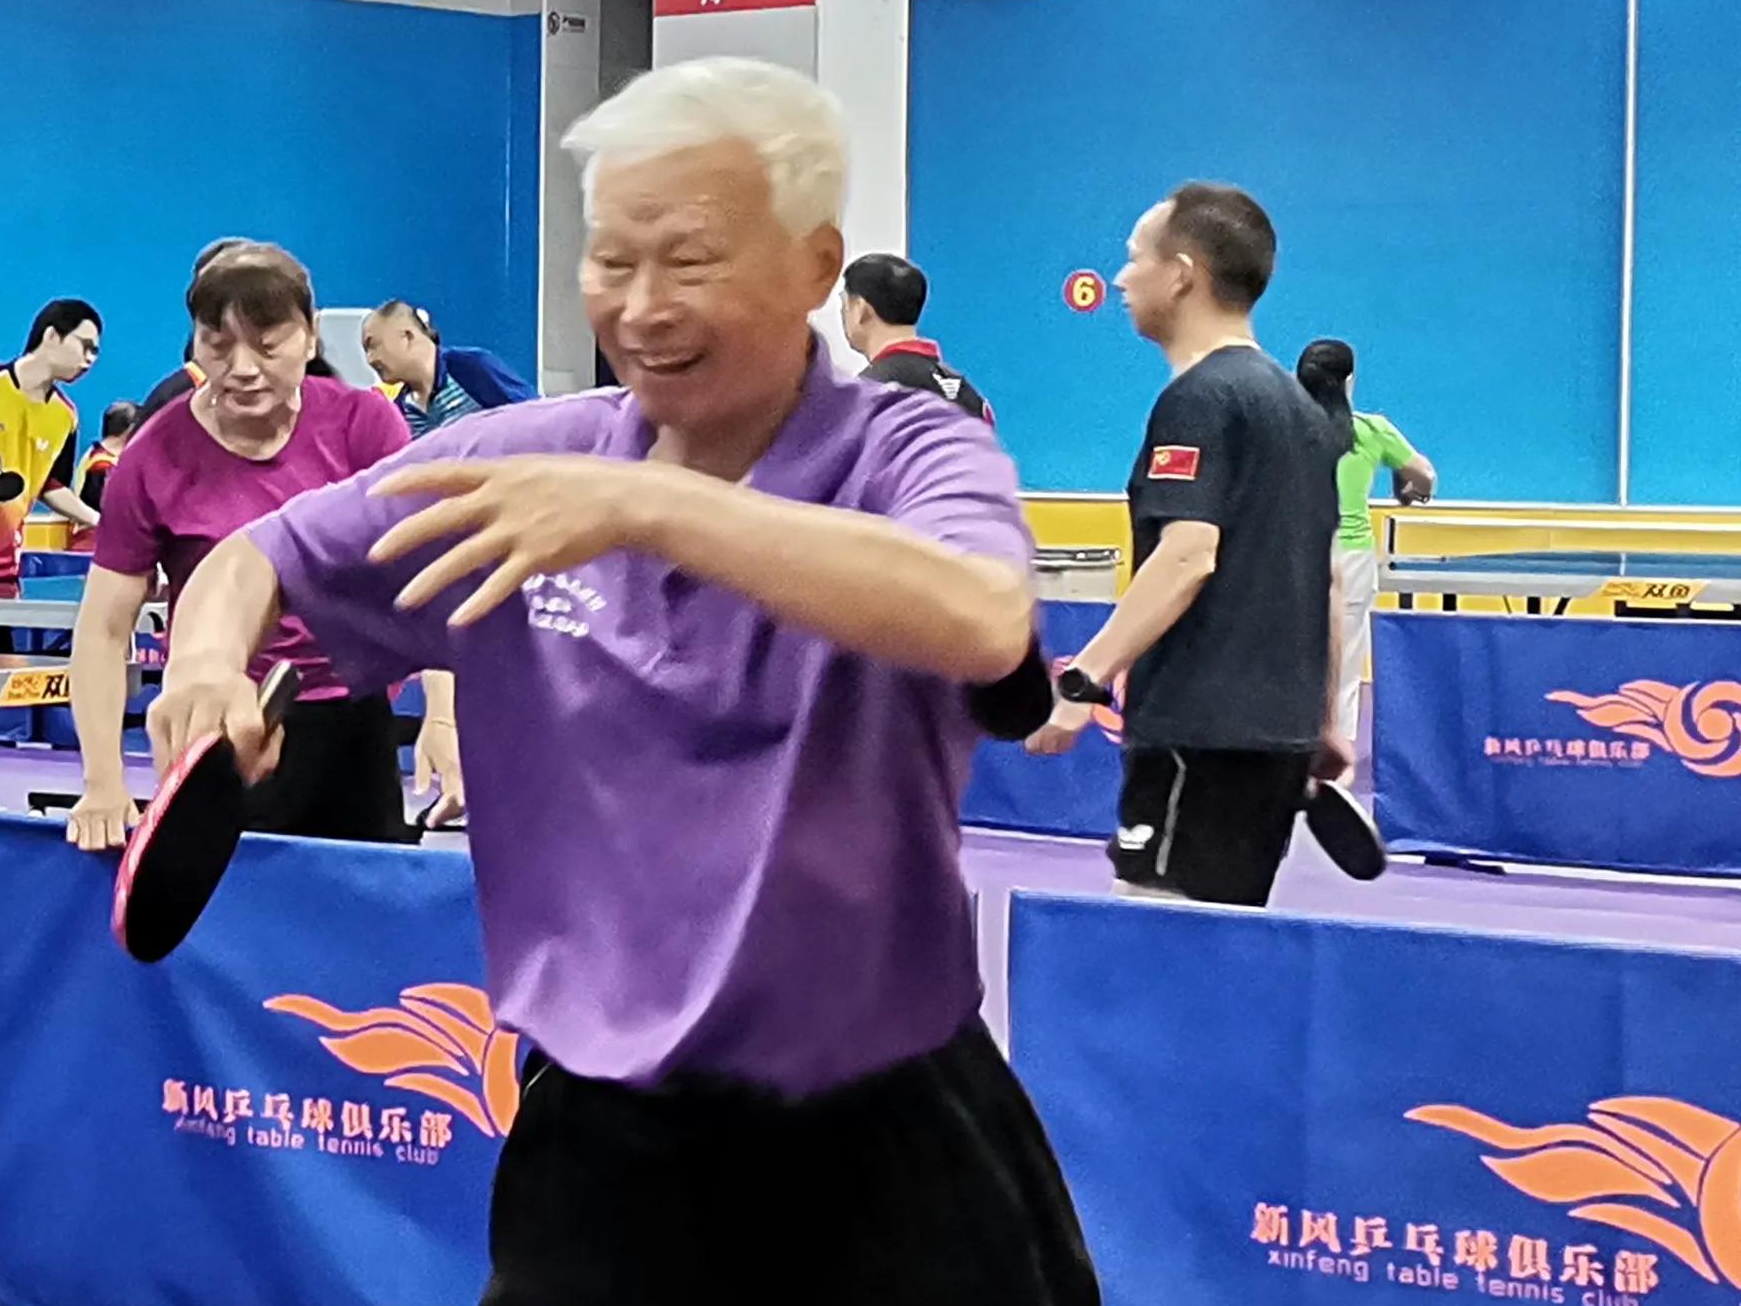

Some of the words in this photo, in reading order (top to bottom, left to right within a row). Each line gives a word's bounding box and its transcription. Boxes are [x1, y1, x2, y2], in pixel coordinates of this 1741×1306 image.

[1072, 276, 1097, 307] 6
[42, 673, 70, 700] 双
[161, 1077, 453, 1149] 新风乒乓球俱乐部
[247, 1125, 305, 1150] table
[318, 1132, 385, 1158] tennis
[395, 1144, 440, 1166] club
[1249, 1201, 1660, 1295] 新风乒乓球俱乐部
[1268, 1248, 1370, 1283] xinfeng
[1386, 1261, 1459, 1291] table
[1476, 1271, 1566, 1305] tennis
